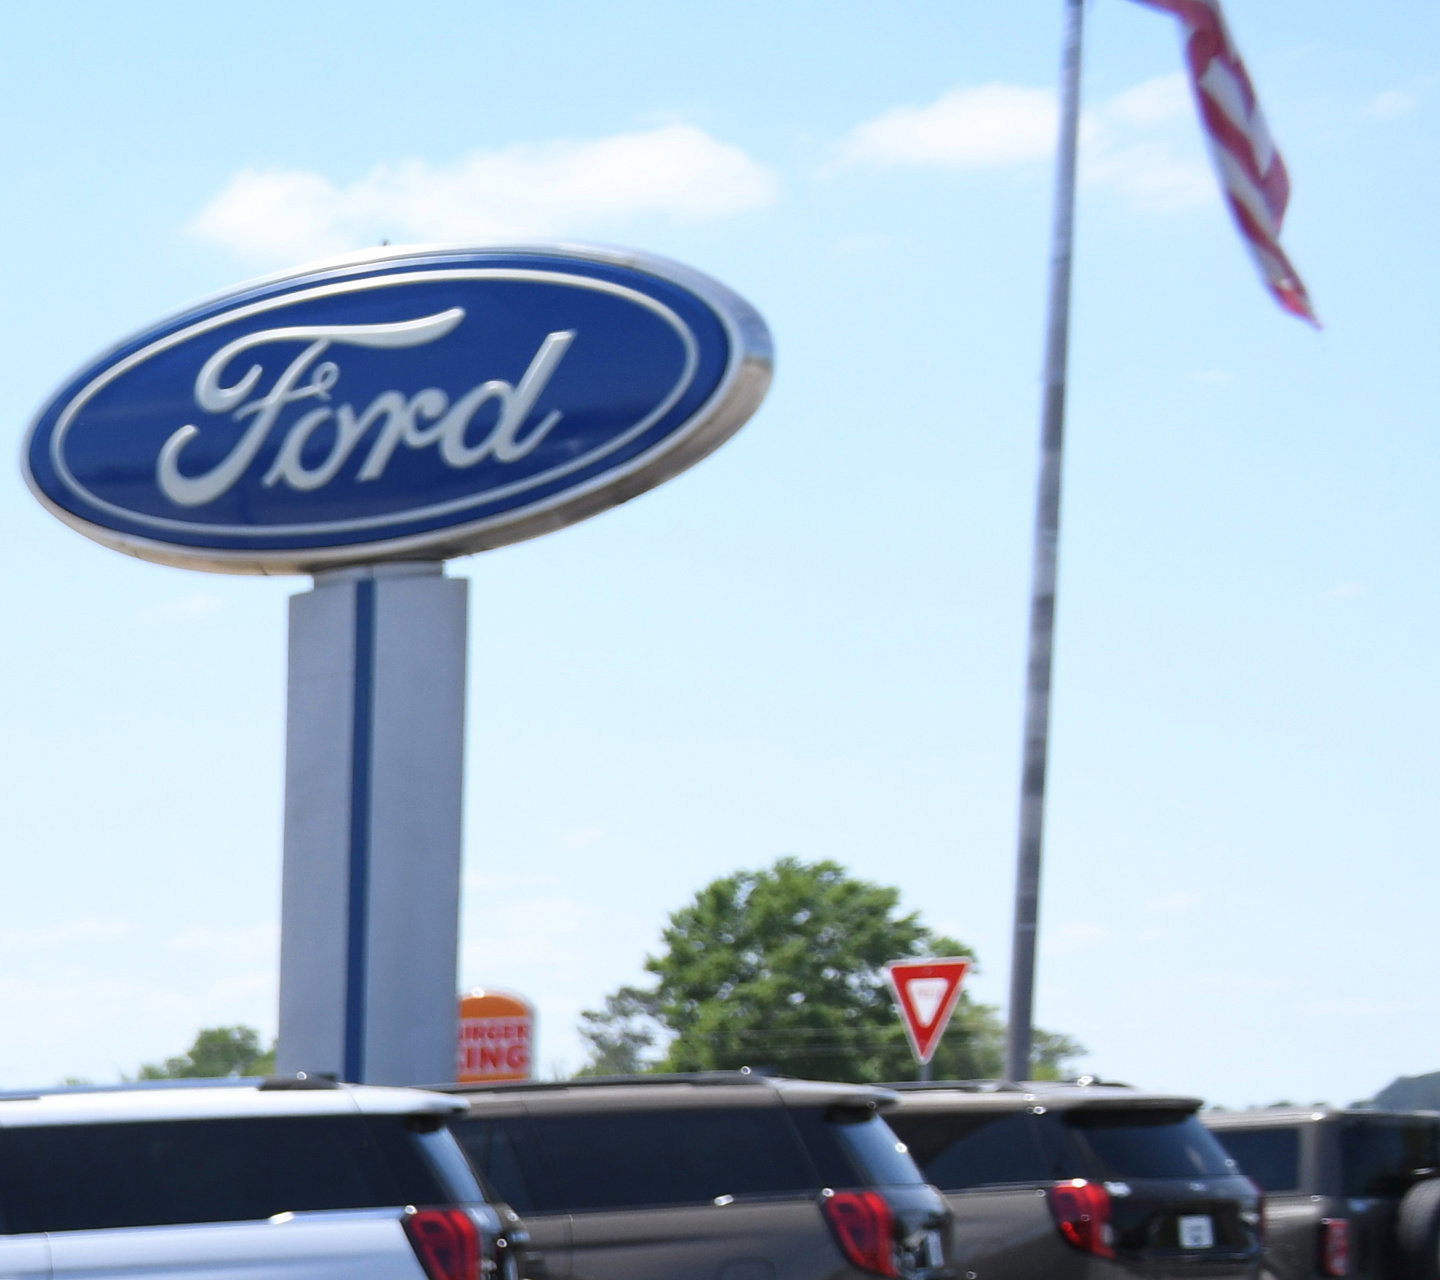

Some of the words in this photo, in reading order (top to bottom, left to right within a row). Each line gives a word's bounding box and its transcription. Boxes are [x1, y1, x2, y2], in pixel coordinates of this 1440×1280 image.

[157, 306, 577, 507] Ford
[458, 1024, 529, 1040] URGER
[458, 1045, 529, 1069] ING
